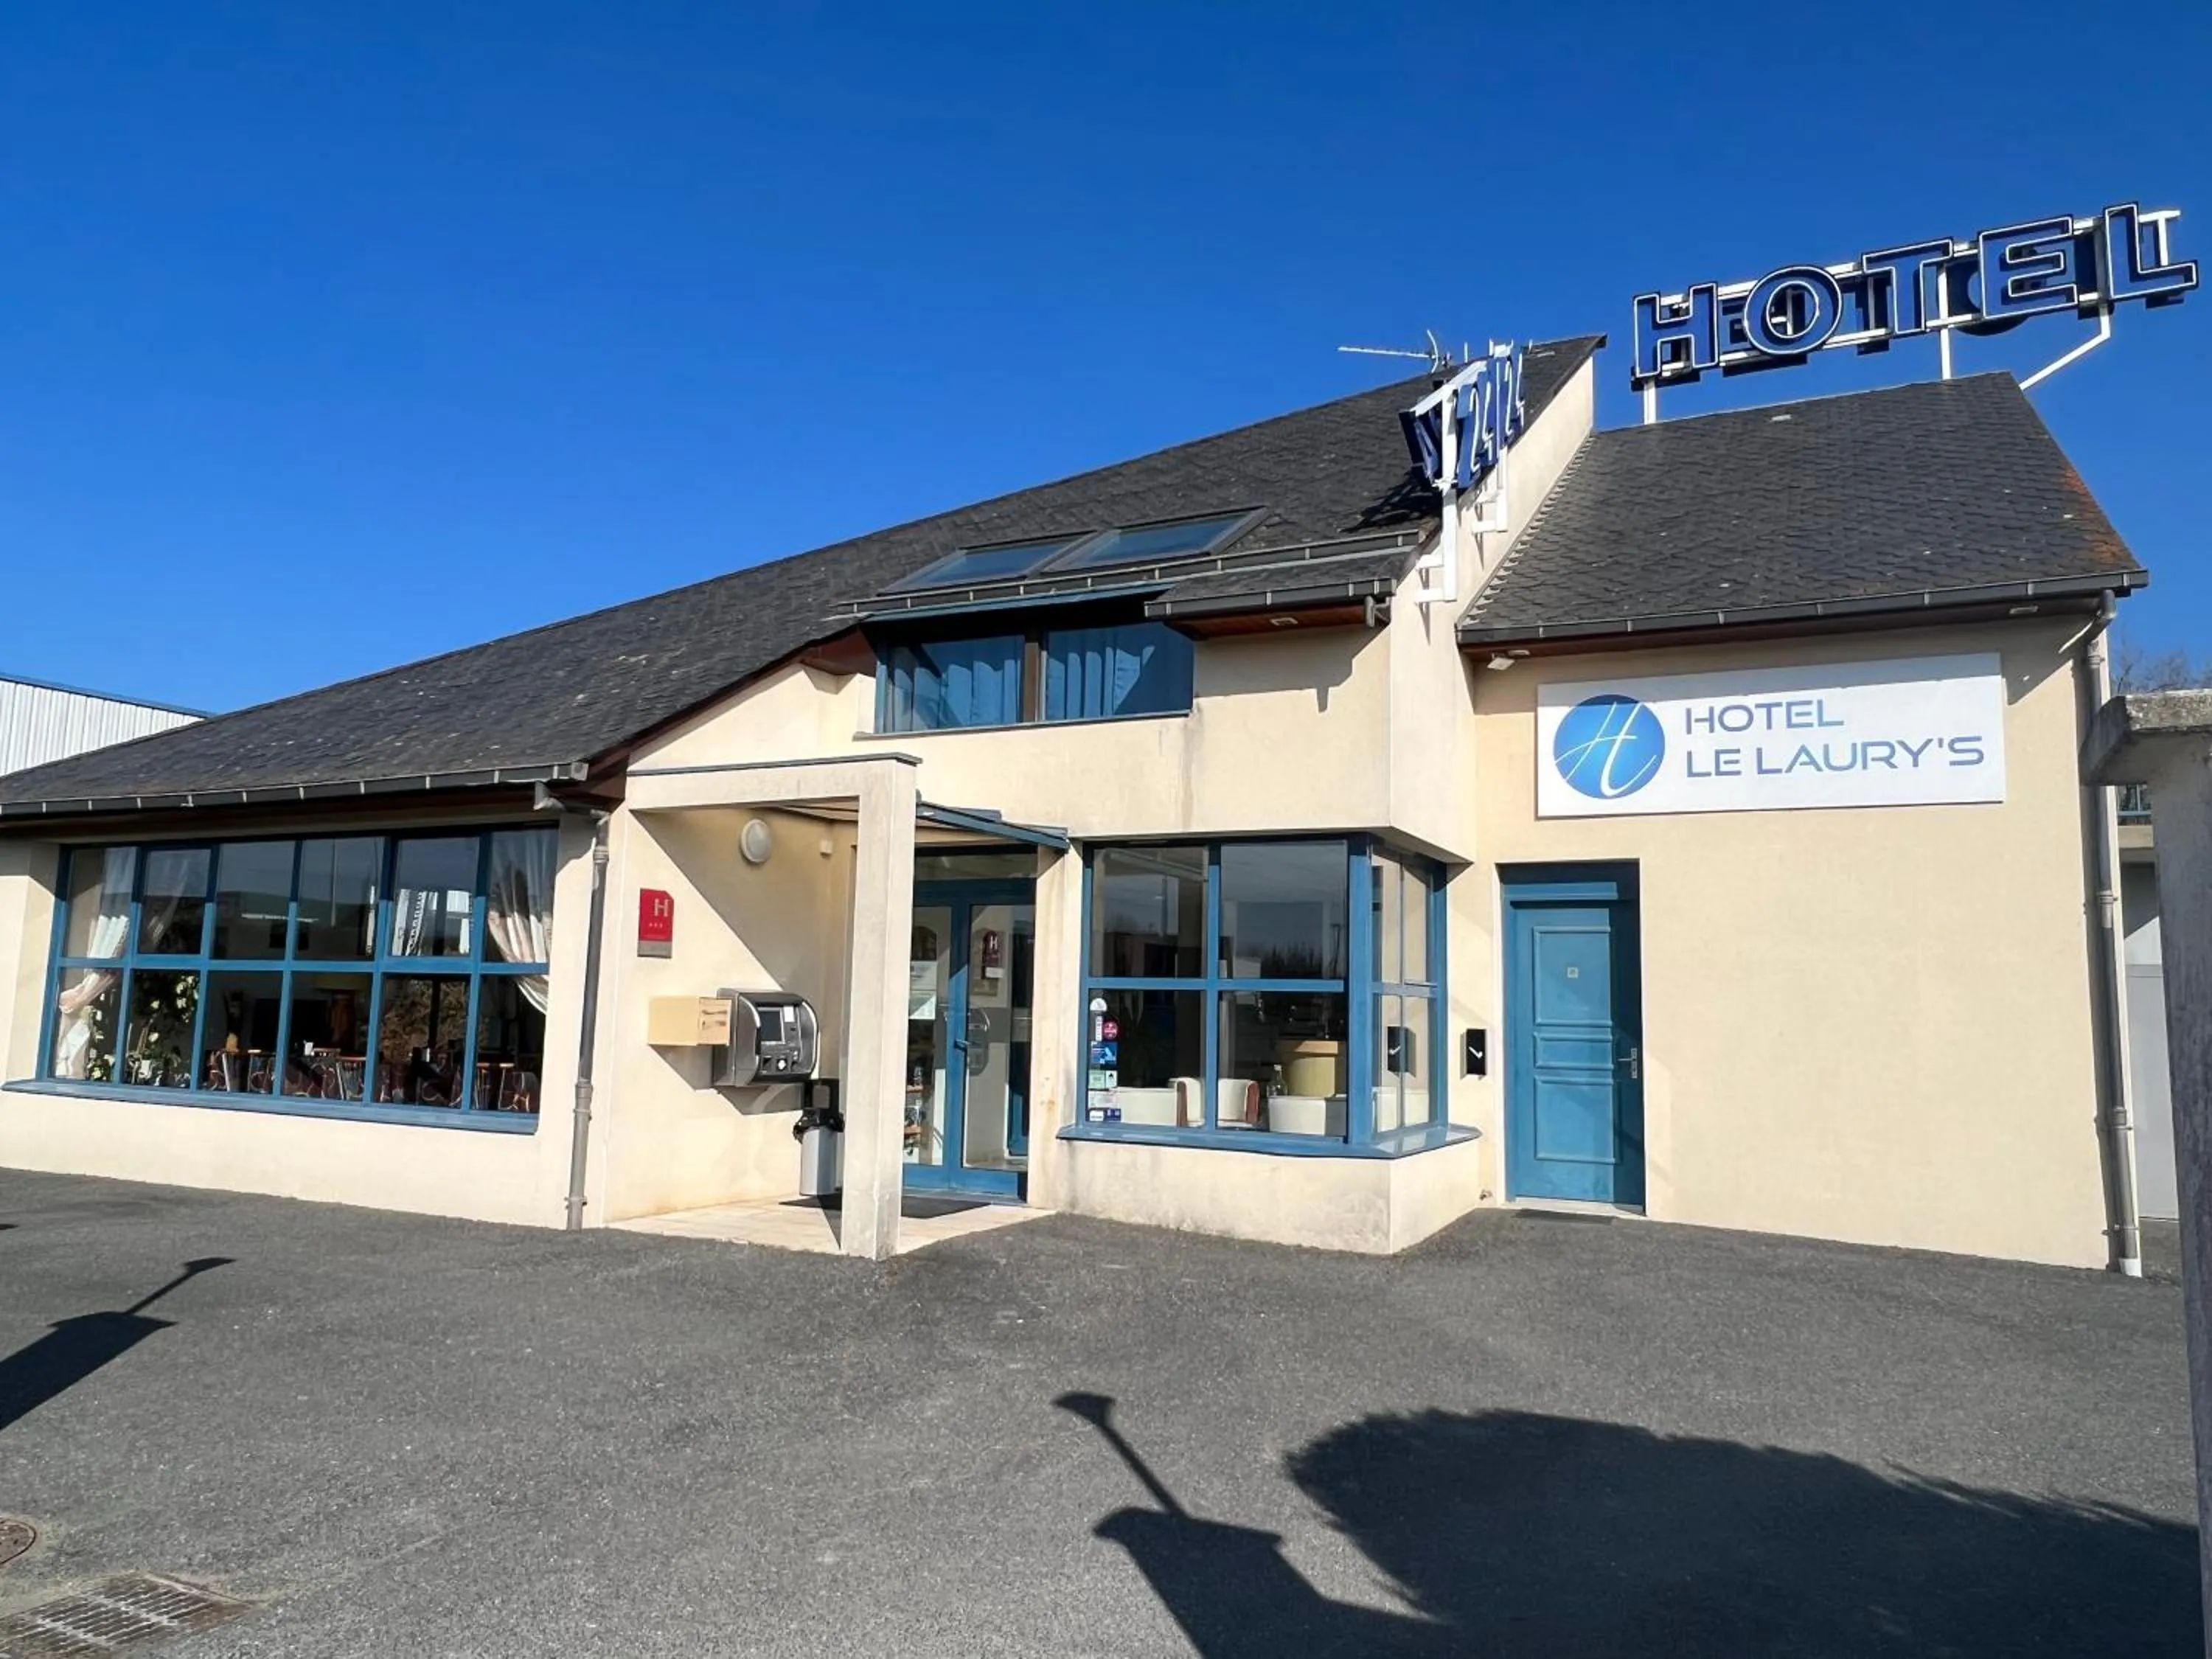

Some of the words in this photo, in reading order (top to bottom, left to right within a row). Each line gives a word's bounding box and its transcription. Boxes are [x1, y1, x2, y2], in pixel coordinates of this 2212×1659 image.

[1632, 201, 2199, 379] HOTEL
[1685, 699, 1844, 736] HOTEL
[1686, 748, 1742, 779] LE
[1756, 735, 1985, 776] LAURY'S
[654, 898, 669, 918] H
